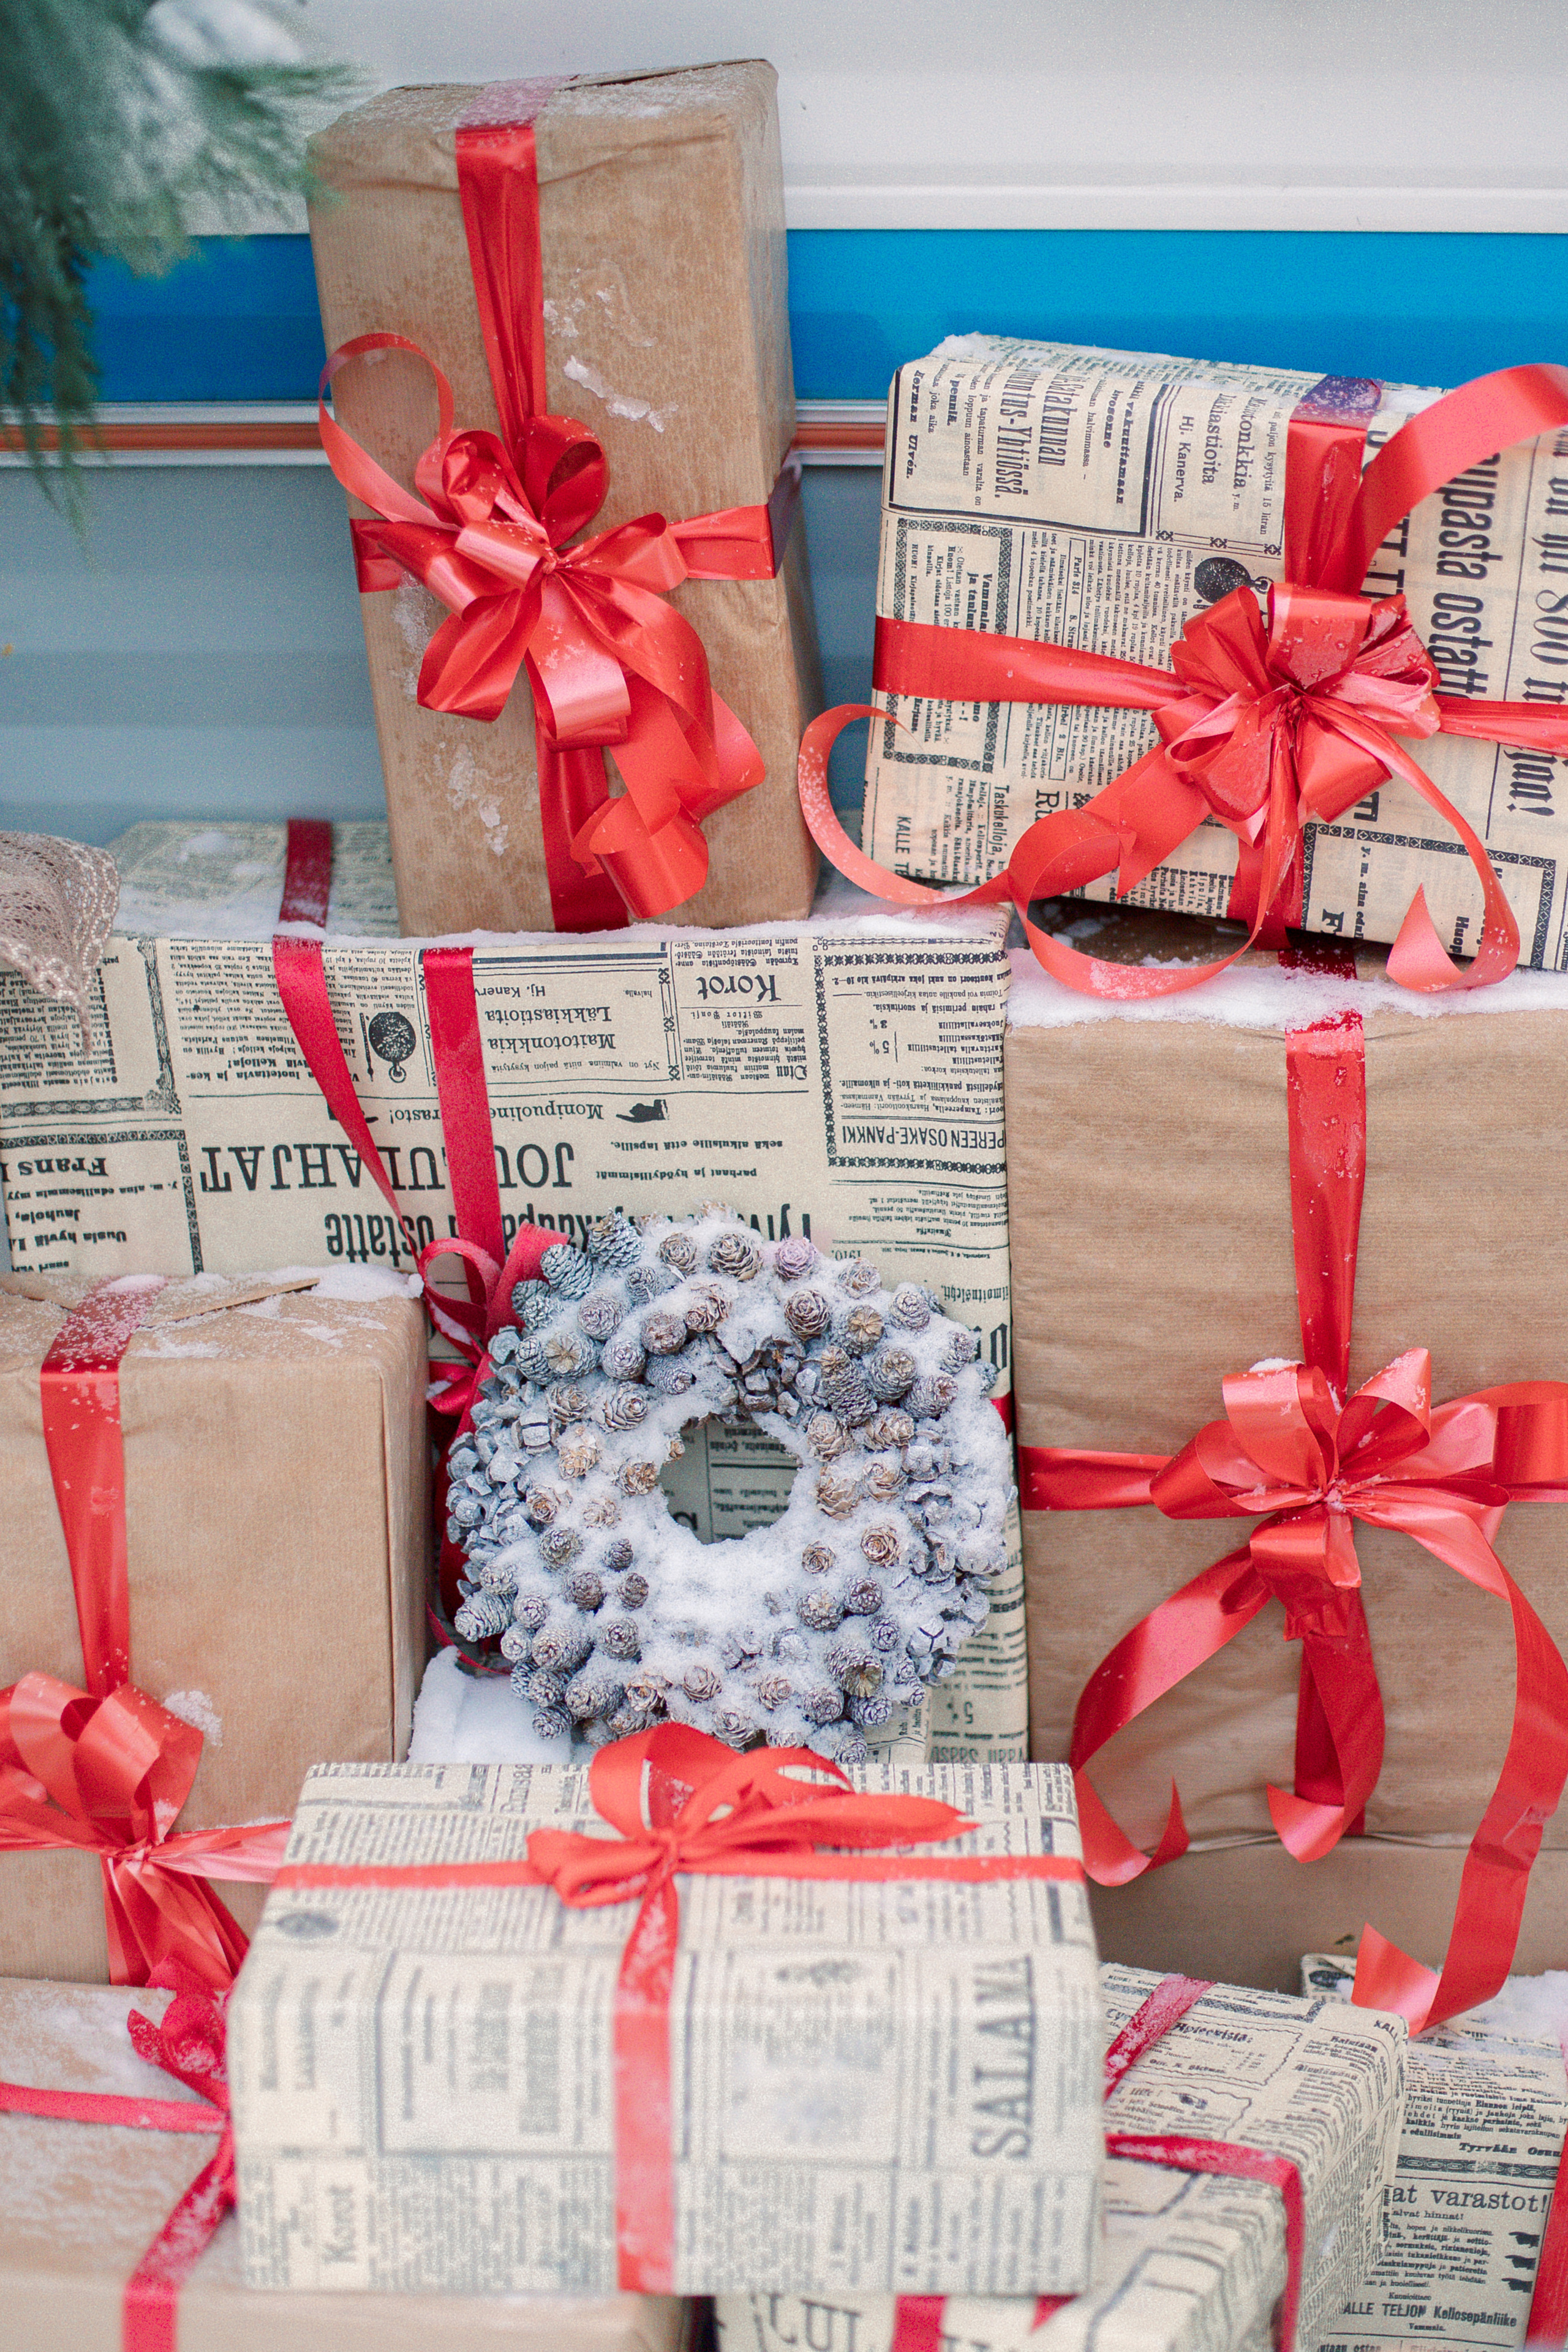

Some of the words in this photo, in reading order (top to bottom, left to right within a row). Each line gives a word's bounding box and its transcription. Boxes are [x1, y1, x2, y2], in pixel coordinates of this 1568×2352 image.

[929, 391, 940, 410] joka
[965, 395, 976, 428] loppuun
[928, 415, 937, 434] aika
[977, 407, 988, 454] tapaturman
[1179, 416, 1194, 435] Hj.
[1083, 412, 1096, 467] halvimmassa
[1267, 422, 1278, 447] paljon
[963, 432, 973, 476] ainoastaan
[1116, 401, 1133, 504] vakuuttamaan
[975, 463, 984, 491] varalta
[1174, 442, 1191, 502] Kanerva.
[1262, 452, 1276, 491] kysytyitä
[975, 496, 981, 505] on
[1262, 497, 1272, 507] 15
[1260, 513, 1270, 535] litran
[989, 785, 1009, 855] Taskukelloja,
[895, 816, 911, 854] KALLE
[526, 984, 545, 997] Hj.
[696, 974, 782, 1002] Korot
[940, 990, 966, 998] pankille
[980, 990, 1003, 998] Toimia
[921, 1003, 927, 1013] ja
[932, 1003, 967, 1013] perimisiä
[484, 1006, 611, 1025] Läkkiastioita
[488, 1033, 616, 1054] Maitotonkkia
[882, 1041, 889, 1054] 5
[491, 1063, 529, 1072] kysytyitä
[534, 1061, 558, 1071] paljon
[564, 1061, 582, 1069] niitä
[589, 1060, 622, 1069] valmiina
[644, 1060, 660, 1069] Nyt
[217, 1071, 228, 1081] ja
[236, 1071, 300, 1080] luotettavia
[843, 1126, 948, 1147] OSAKE-PANKKI
[611, 1141, 658, 1151] lapsille.
[663, 1141, 687, 1150] että
[693, 1140, 748, 1150] aikuisille
[754, 1141, 783, 1150] sekä
[18, 1158, 108, 1177] Frans
[694, 1167, 705, 1177] ja
[711, 1169, 756, 1178] parhaat
[596, 1169, 688, 1180] hyödyllisimmät
[1431, 2190, 1547, 2213] varastot!
